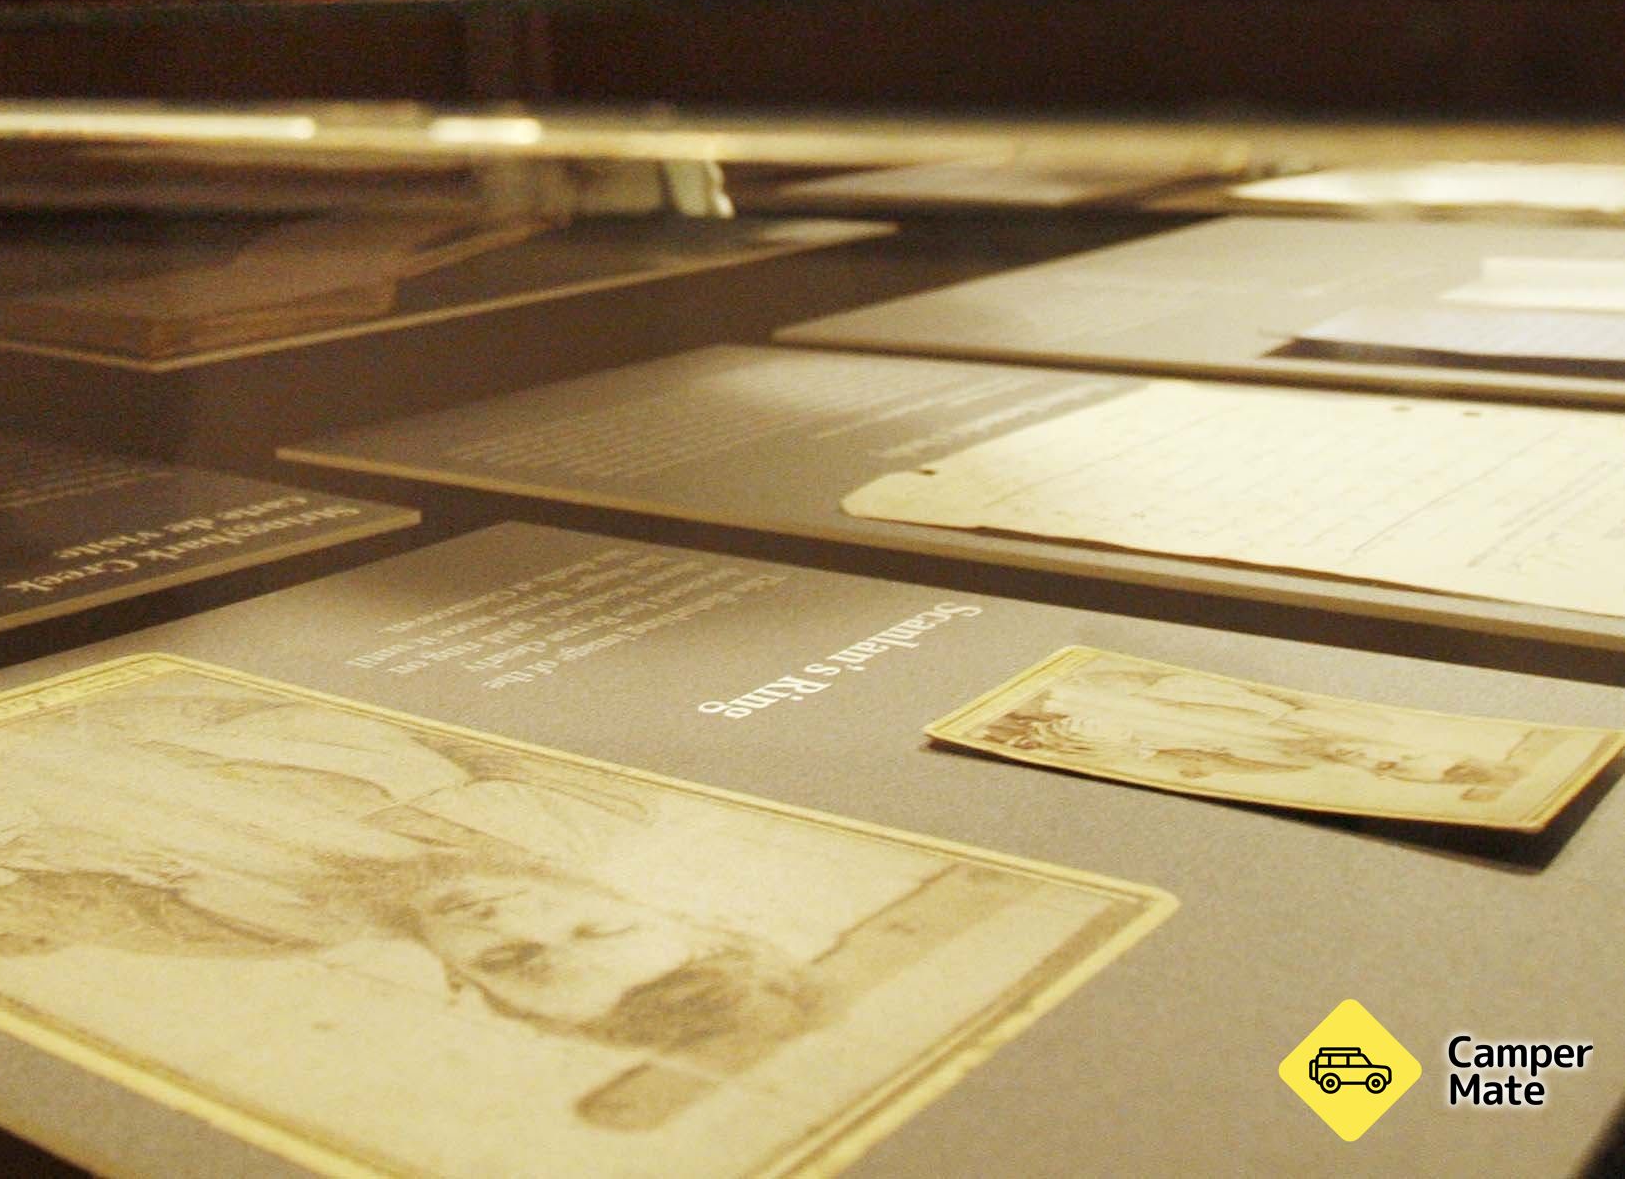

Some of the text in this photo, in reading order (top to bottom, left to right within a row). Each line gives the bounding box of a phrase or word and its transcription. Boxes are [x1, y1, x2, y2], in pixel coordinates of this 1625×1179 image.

[4, 559, 138, 592] Creek
[521, 659, 565, 676] of
[697, 602, 982, 719] Scanlan's Ring
[478, 671, 540, 690] the
